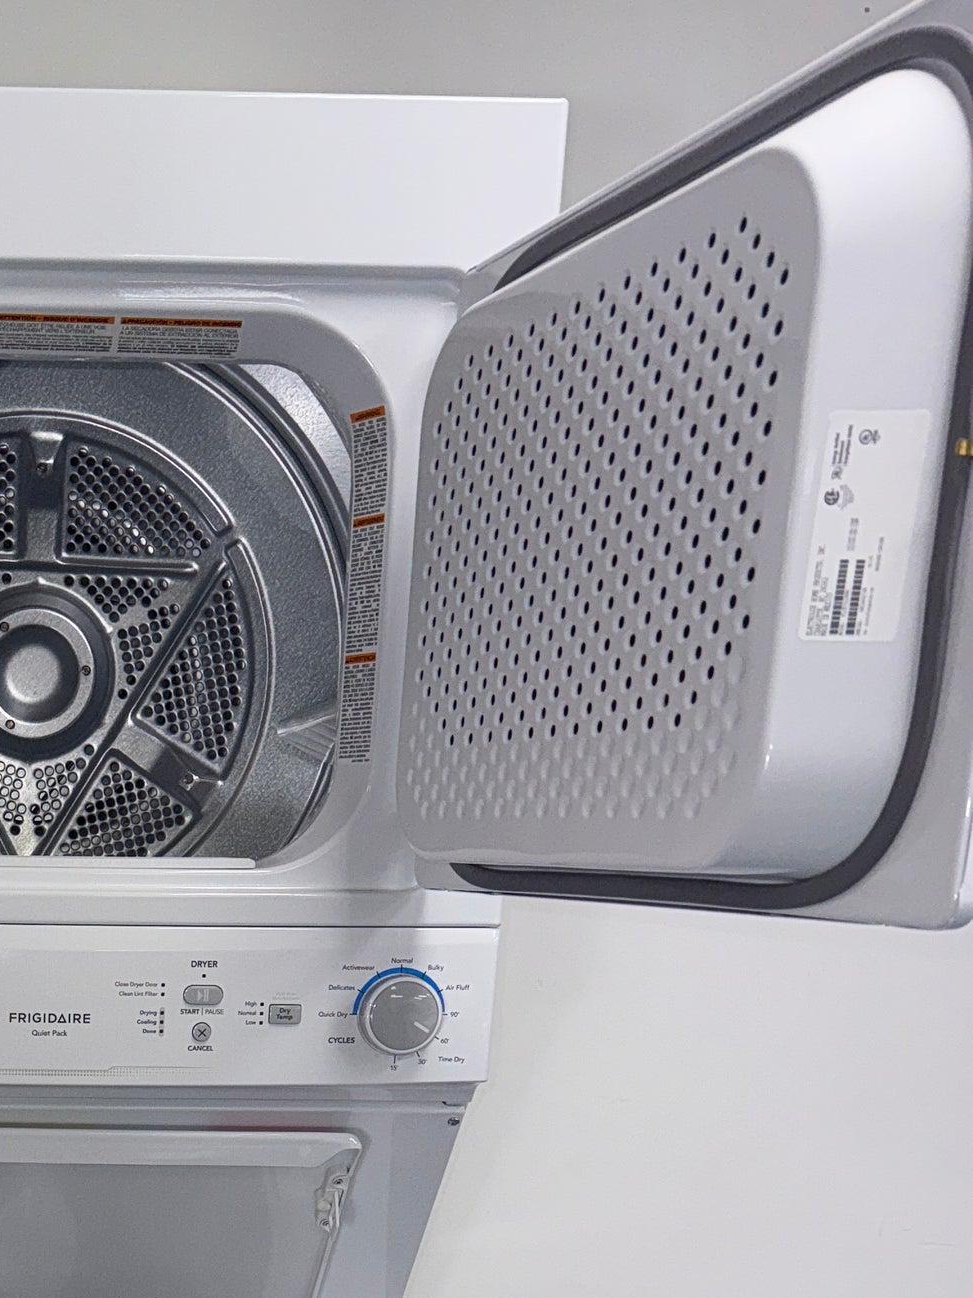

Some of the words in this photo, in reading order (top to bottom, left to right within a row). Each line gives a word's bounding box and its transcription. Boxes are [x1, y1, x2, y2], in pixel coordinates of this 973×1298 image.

[191, 960, 218, 968] DRYER
[428, 964, 444, 972] Bulky
[9, 1012, 91, 1024] FRIGIDAIRE
